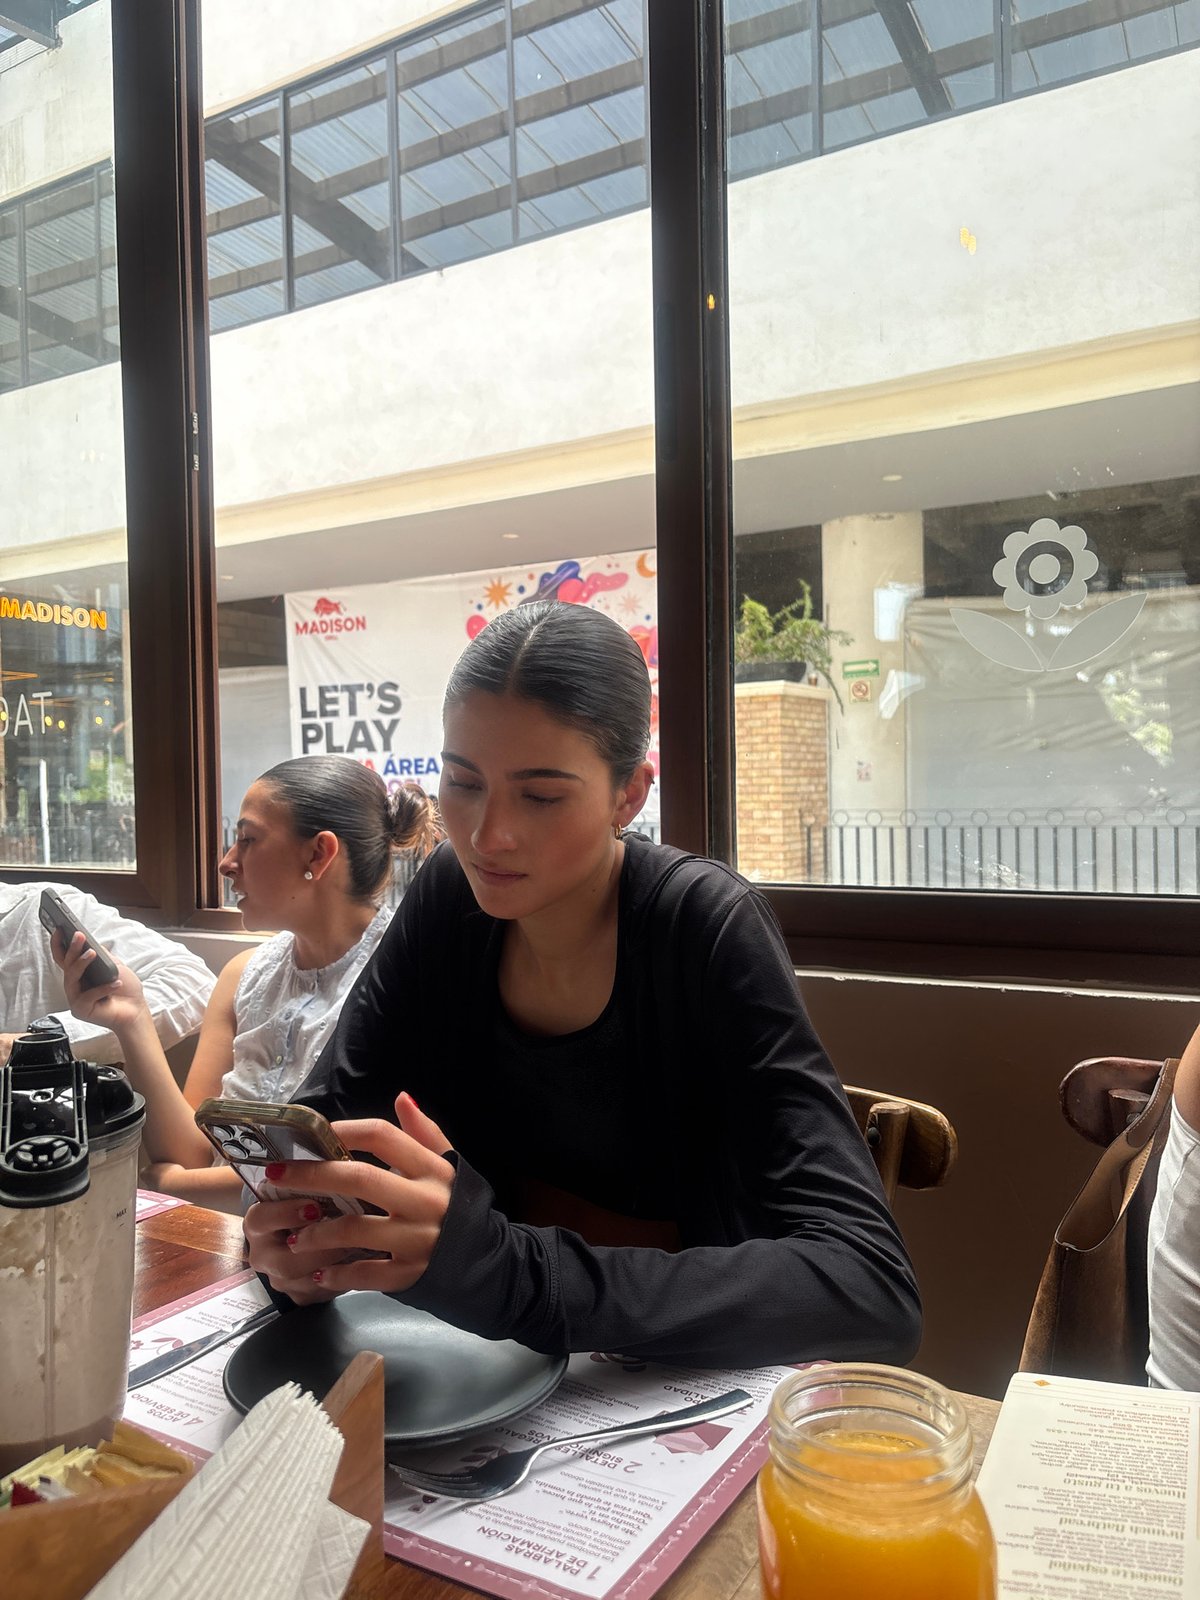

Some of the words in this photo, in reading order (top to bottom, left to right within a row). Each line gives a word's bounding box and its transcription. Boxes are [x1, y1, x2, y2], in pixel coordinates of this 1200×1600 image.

[0, 597, 107, 630] MADISON
[295, 616, 366, 635] MADISON
[299, 681, 402, 719] LET’S
[301, 719, 401, 755] PLAY
[383, 753, 440, 775] ÁREA
[663, 1385, 715, 1400] ALIDAD
[131, 1393, 177, 1416] SERVICIO
[147, 1408, 182, 1423] ACTOS
[183, 1417, 203, 1426] 4
[552, 1443, 618, 1469] DETALLES
[621, 1459, 643, 1474] 2
[1063, 1478, 1101, 1487] gusto
[1105, 1482, 1120, 1490] tu
[1135, 1486, 1185, 1499] Huevos
[588, 1515, 620, 1530] alegra
[597, 1511, 610, 1519] en
[1058, 1516, 1125, 1532] flatbread
[1129, 1524, 1183, 1540] Brunch
[474, 1524, 567, 1559] AFIRMACIÓN
[564, 1541, 602, 1557] palabras
[586, 1542, 620, 1557] Quienes
[503, 1543, 582, 1576] PALABRAS
[565, 1555, 589, 1568] DE
[1048, 1559, 1108, 1574] español
[584, 1565, 604, 1581] 1
[1110, 1567, 1182, 1586] Omelette
